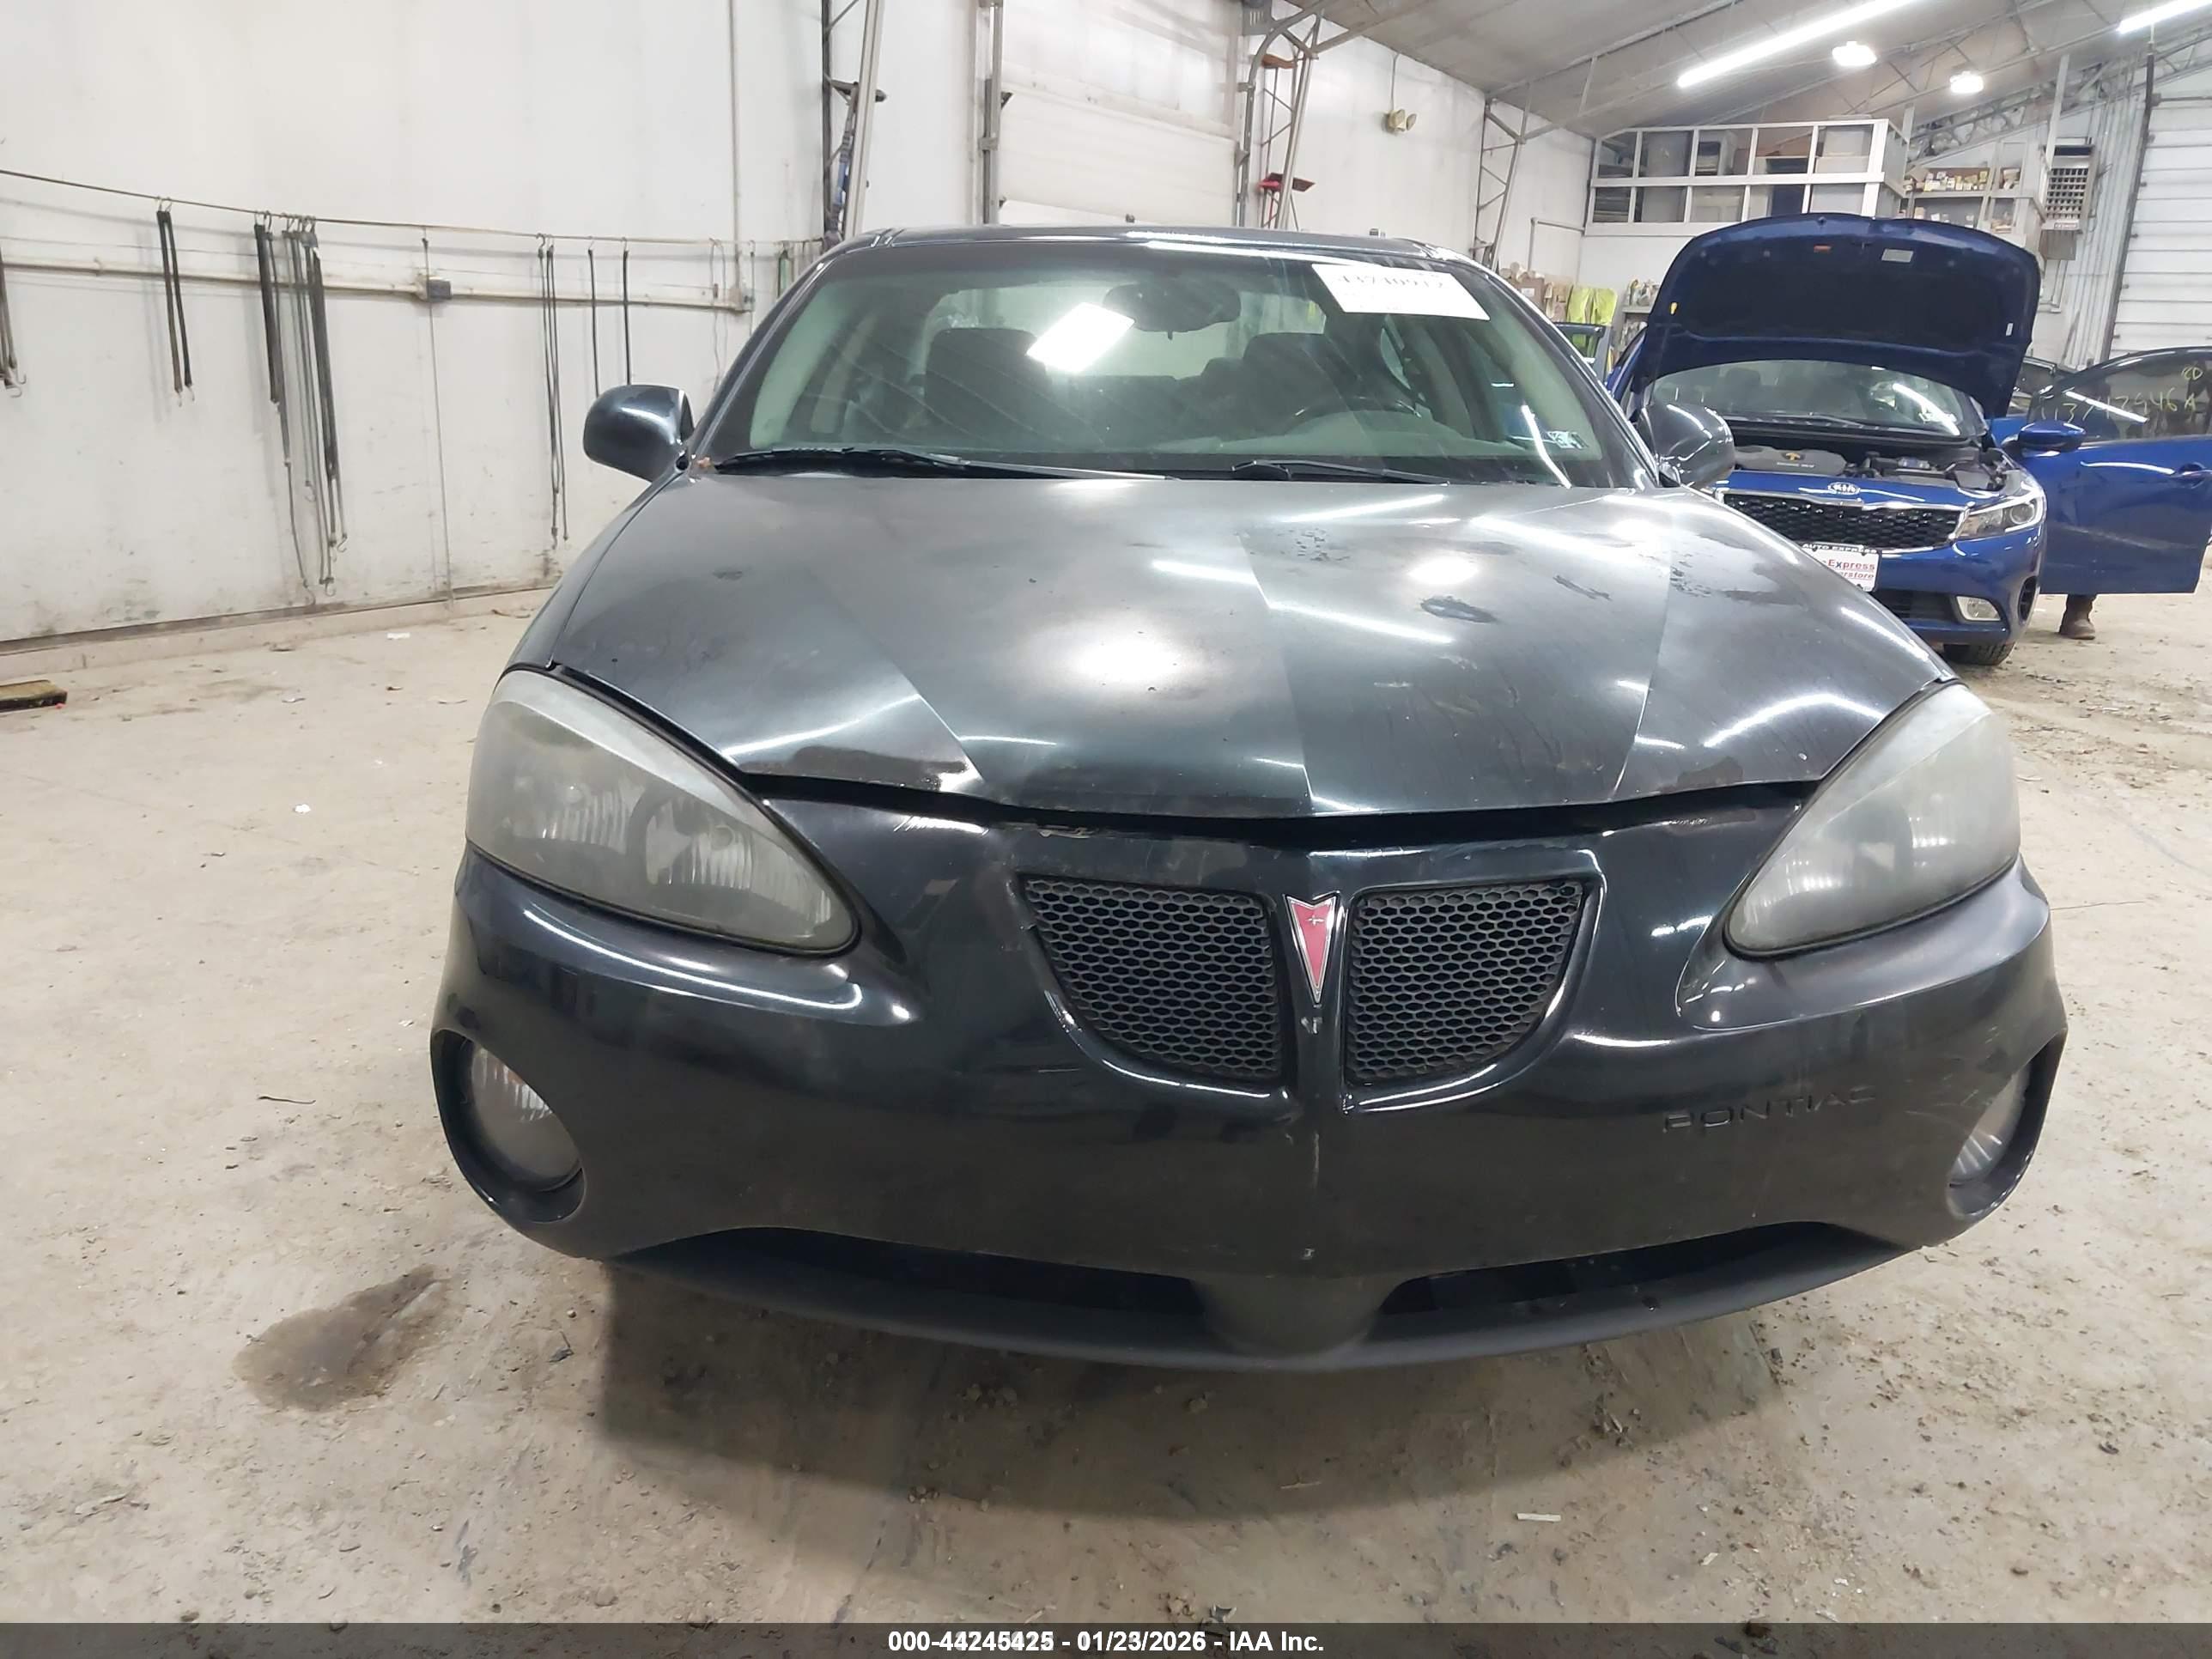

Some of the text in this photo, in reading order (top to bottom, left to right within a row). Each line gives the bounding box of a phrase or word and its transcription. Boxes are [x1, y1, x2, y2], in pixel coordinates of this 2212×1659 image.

[1802, 543, 1829, 551] AUTO
[1827, 559, 1875, 570] Express
[1662, 1085, 1876, 1133] PONTIAC
